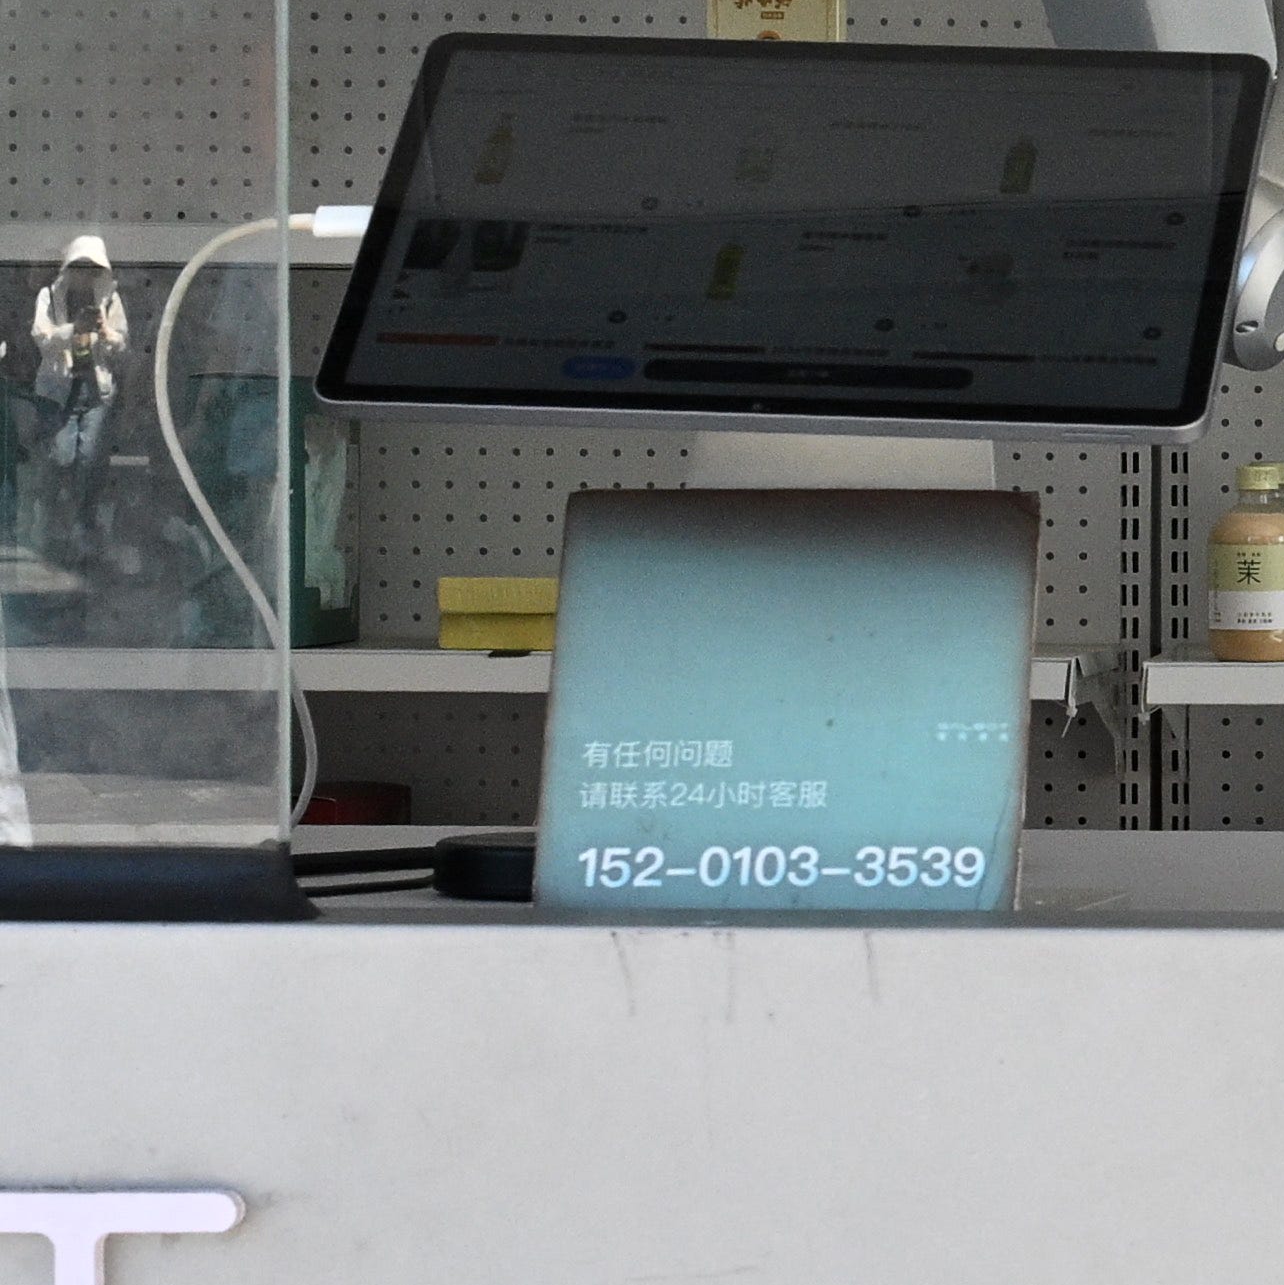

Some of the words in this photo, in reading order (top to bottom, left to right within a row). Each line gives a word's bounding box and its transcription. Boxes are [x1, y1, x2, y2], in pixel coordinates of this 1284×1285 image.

[1236, 559, 1262, 585] 茉
[582, 739, 734, 769] 有任何问题
[578, 779, 828, 810] 请联系24小时客服
[577, 844, 987, 888] 152-0103-3539
